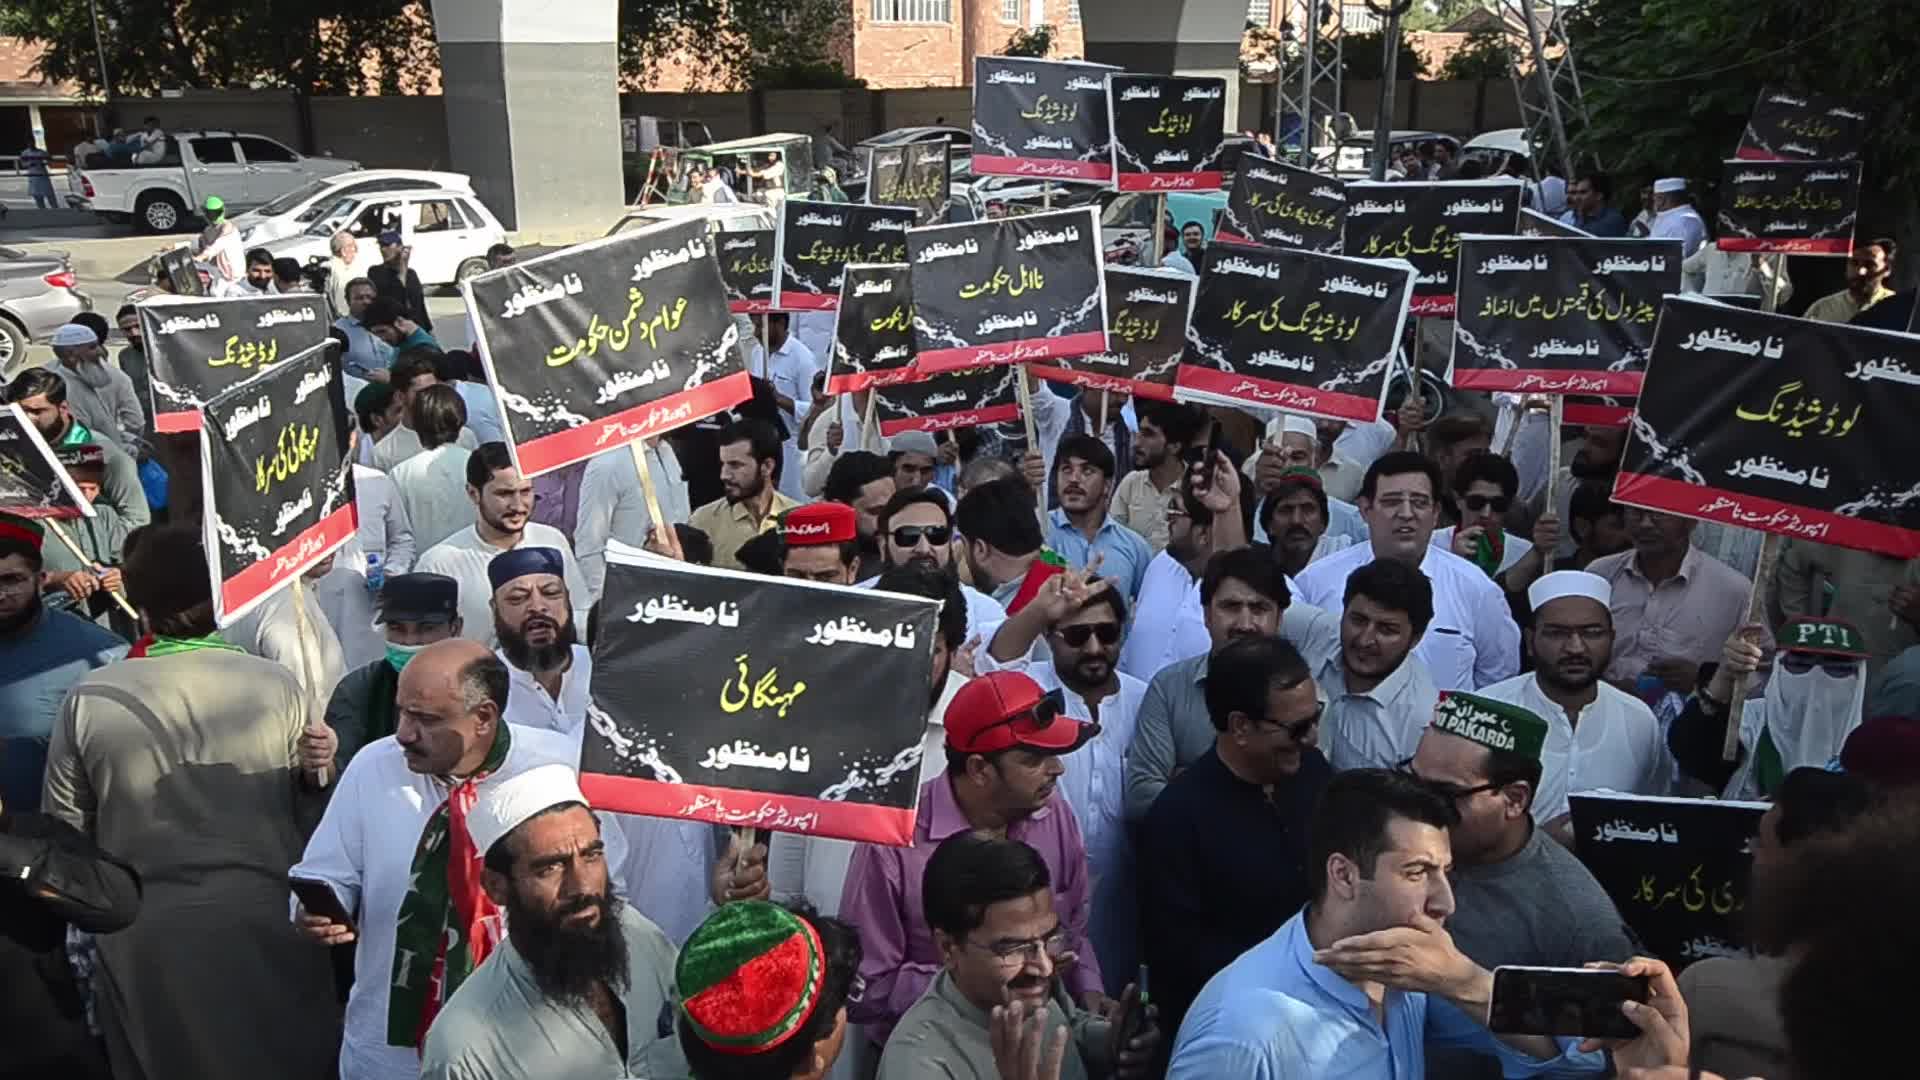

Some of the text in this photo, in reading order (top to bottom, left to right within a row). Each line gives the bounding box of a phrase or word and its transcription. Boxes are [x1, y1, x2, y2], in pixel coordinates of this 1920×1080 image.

[1346, 199, 1406, 217] نامنظور
[1443, 199, 1504, 216] نامنظور
[916, 239, 979, 263] نامنظور
[1015, 224, 1079, 253] نامنظور
[1395, 225, 1413, 257] کی
[631, 238, 706, 281] نامنظور
[1211, 256, 1281, 280] نامنظور
[1476, 255, 1548, 275] نامنظور
[1592, 256, 1666, 275] نامنظور
[501, 272, 584, 318] نامنظور
[959, 265, 1011, 299] حکومت
[1126, 287, 1178, 304] نامنظور
[1319, 275, 1388, 299] نامنظور
[1222, 300, 1262, 328] سرکار
[1259, 296, 1285, 332] کی
[1478, 295, 1514, 317] اضافہ
[1515, 294, 1541, 318] میں
[1542, 283, 1590, 320] قیمتوں
[1587, 287, 1606, 320] کی
[158, 313, 221, 335] نامنظور
[257, 306, 315, 328] نامنظور
[976, 308, 1038, 336] نامنظور
[546, 314, 610, 368] حکومت
[1528, 339, 1600, 358] نامنظور
[1680, 327, 1785, 359] نامنظور
[1247, 350, 1315, 373] نامنظور
[595, 358, 671, 404] نامنظور
[1726, 455, 1830, 489] نامنظور
[626, 594, 739, 627] نامنظور
[806, 616, 915, 649] نامنظور
[1797, 623, 1851, 648] PTI
[1446, 713, 1516, 751] PAKARDA
[699, 740, 811, 773] نامنظور
[1592, 818, 1679, 843] نامنظور
